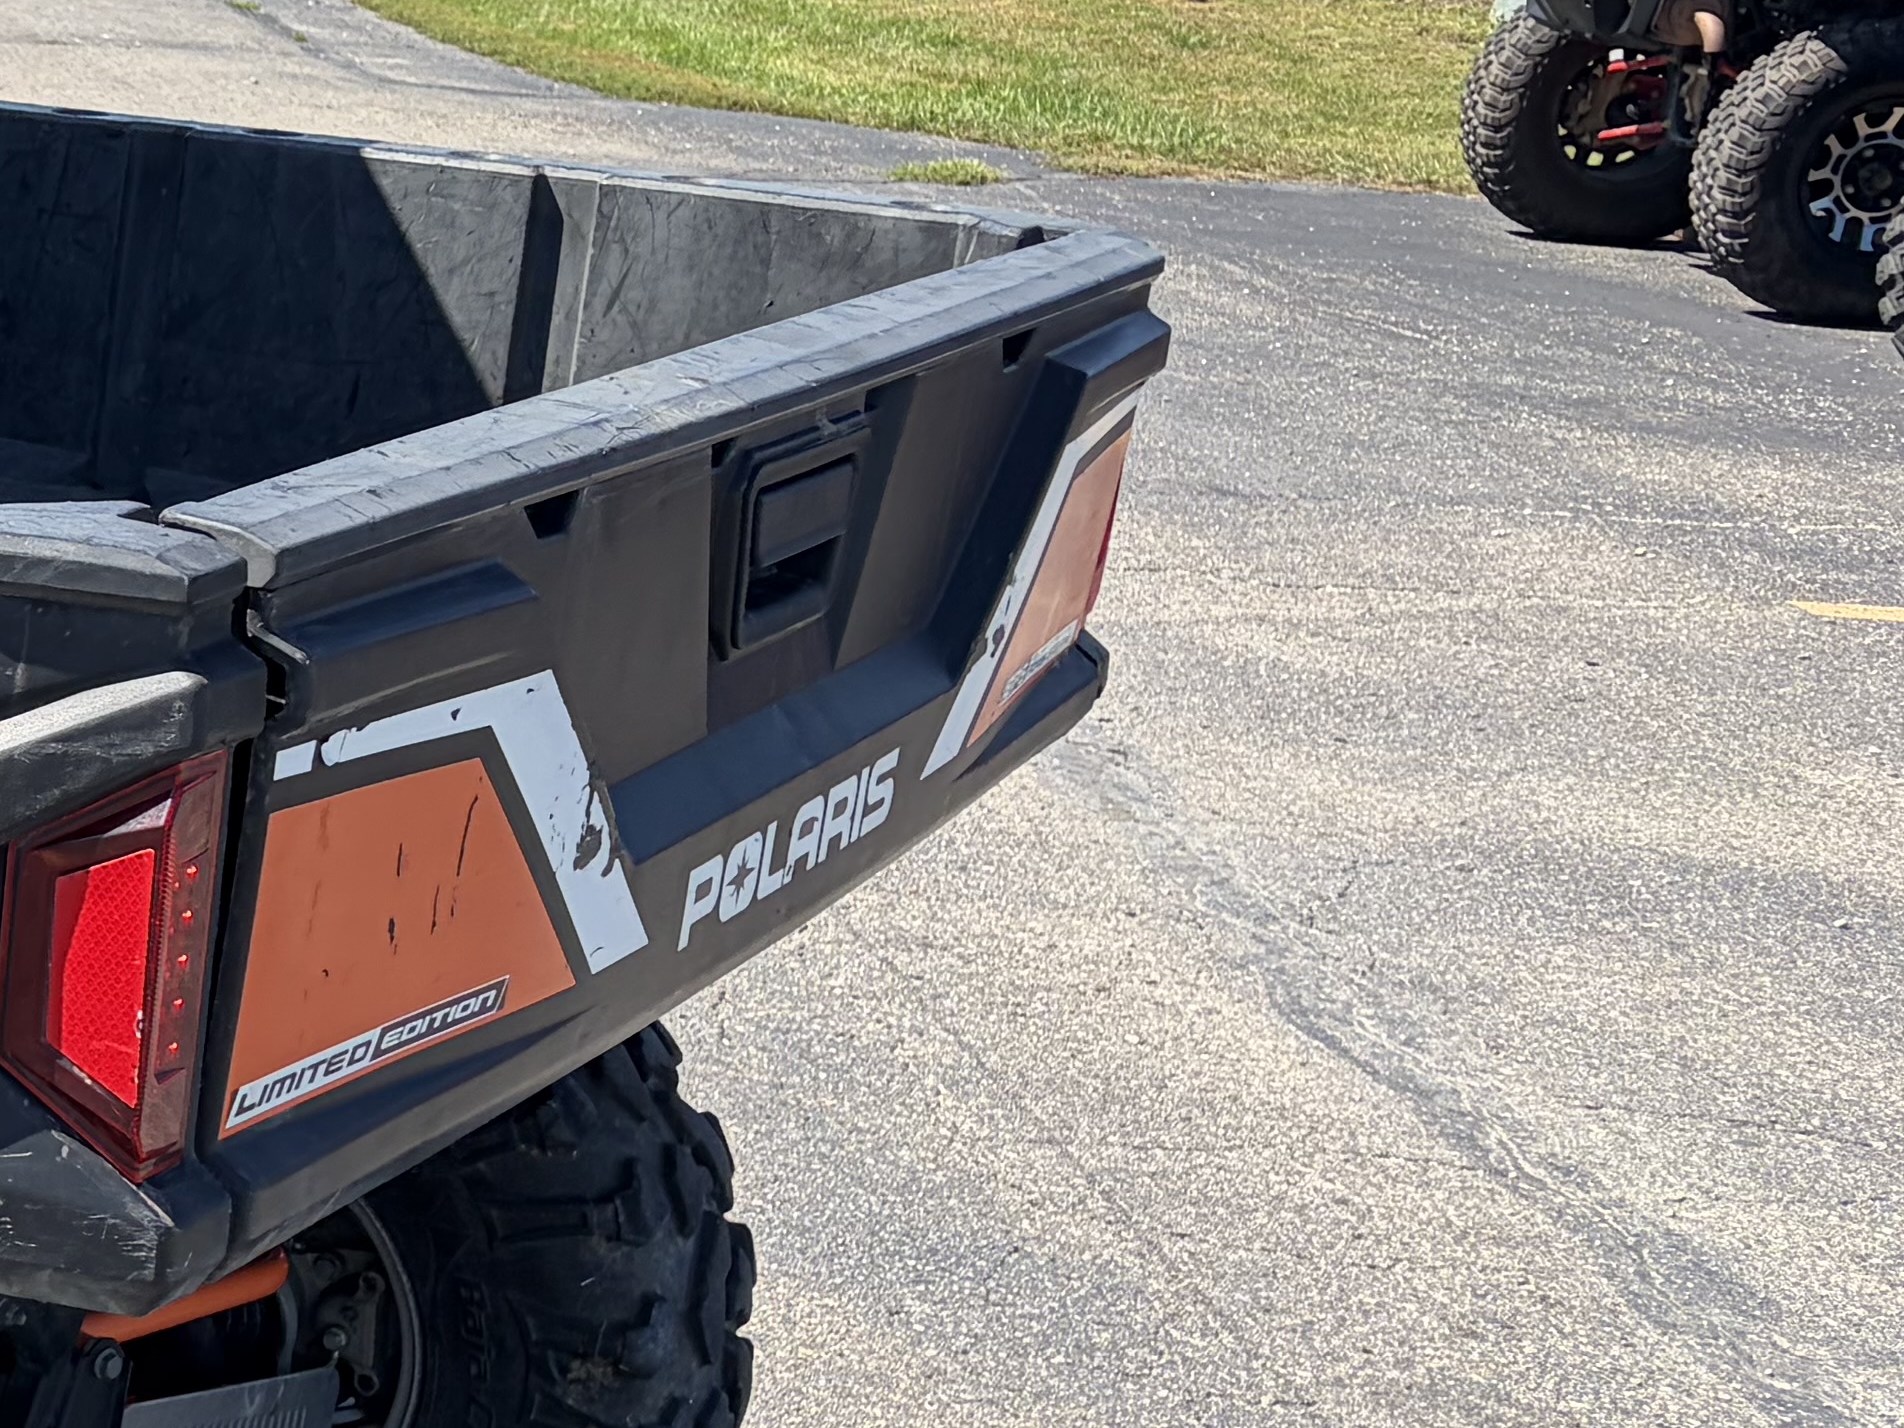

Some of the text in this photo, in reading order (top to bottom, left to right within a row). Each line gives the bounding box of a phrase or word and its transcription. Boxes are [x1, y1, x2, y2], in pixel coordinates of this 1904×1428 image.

[676, 747, 901, 953] POLARIS
[236, 983, 499, 1116] LIMITED EDITION
